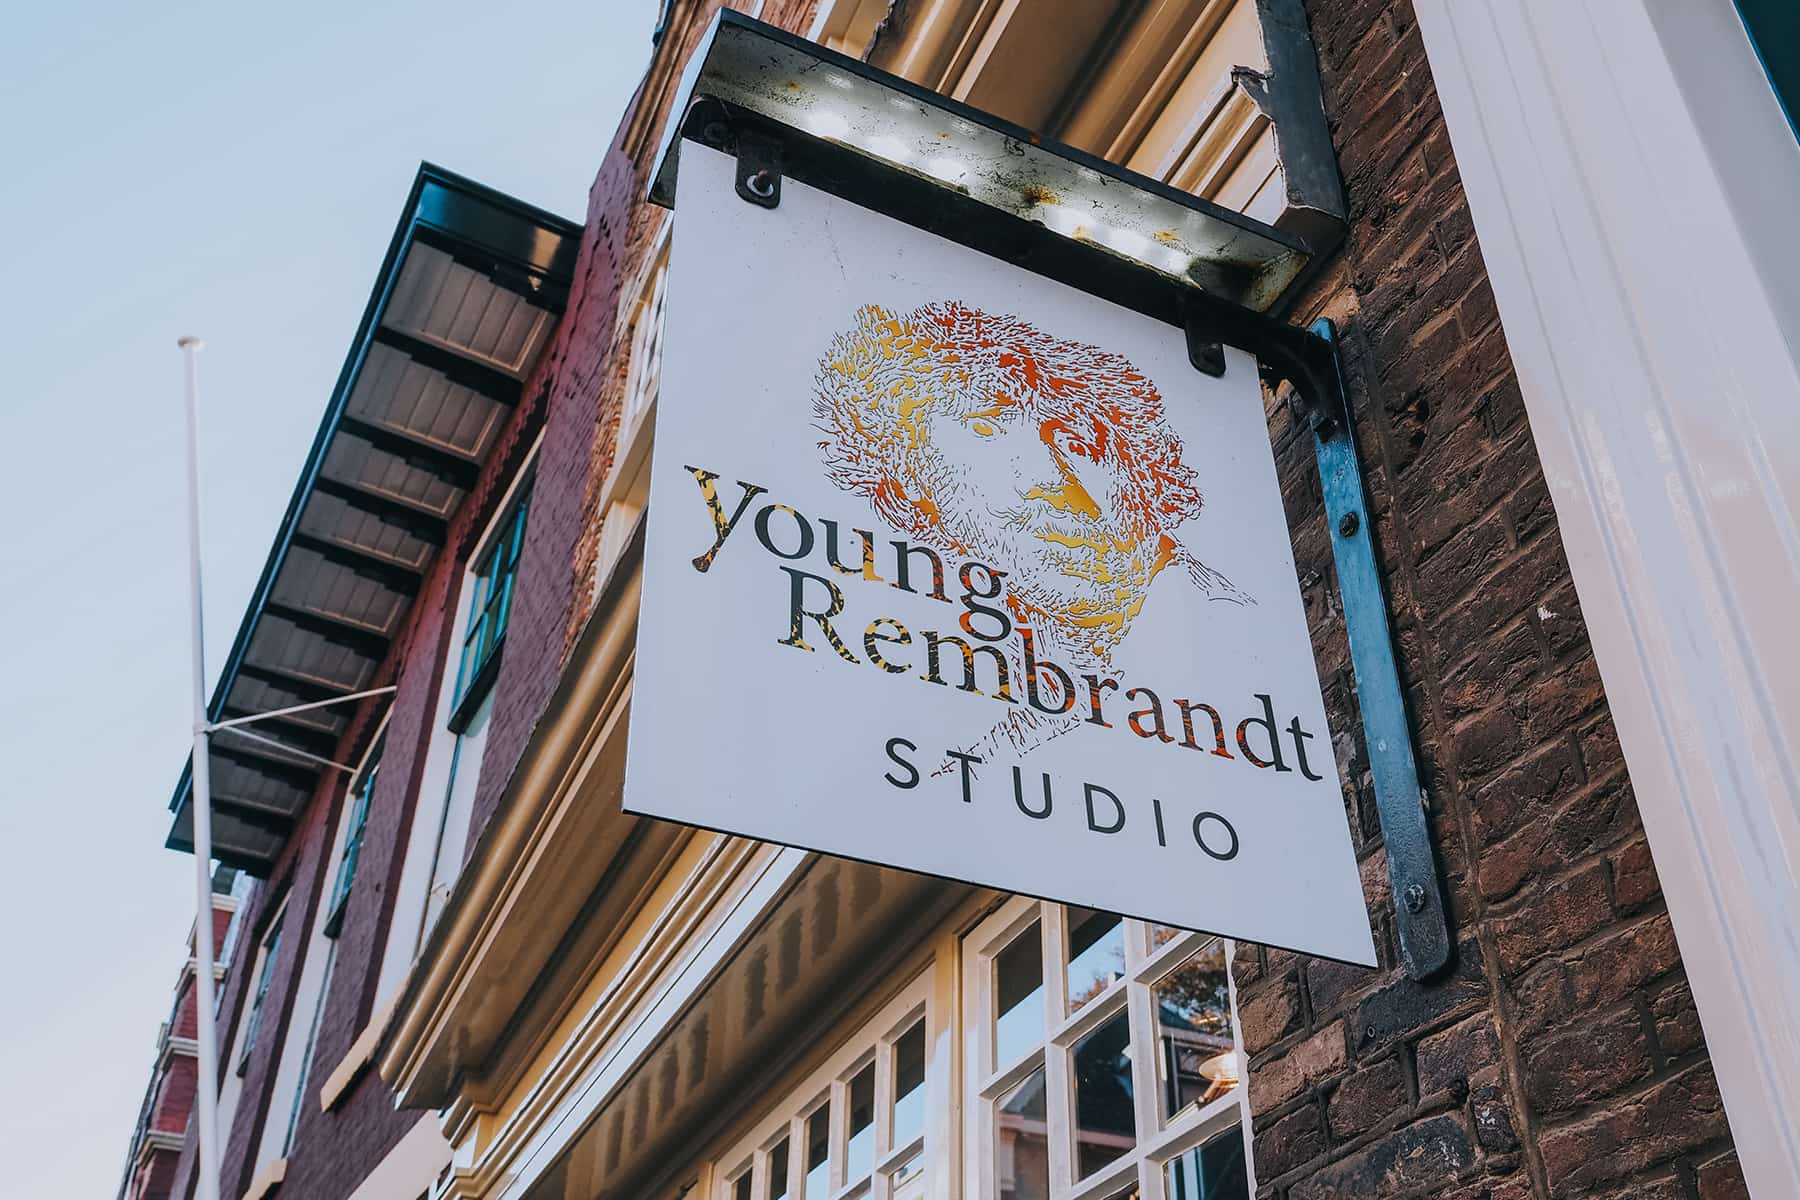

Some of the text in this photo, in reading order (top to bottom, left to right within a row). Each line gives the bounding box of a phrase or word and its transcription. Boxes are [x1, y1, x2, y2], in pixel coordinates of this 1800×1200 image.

[684, 464, 1011, 642] young
[777, 565, 1324, 782] Rembrandt
[884, 737, 1240, 861] STUDIO
